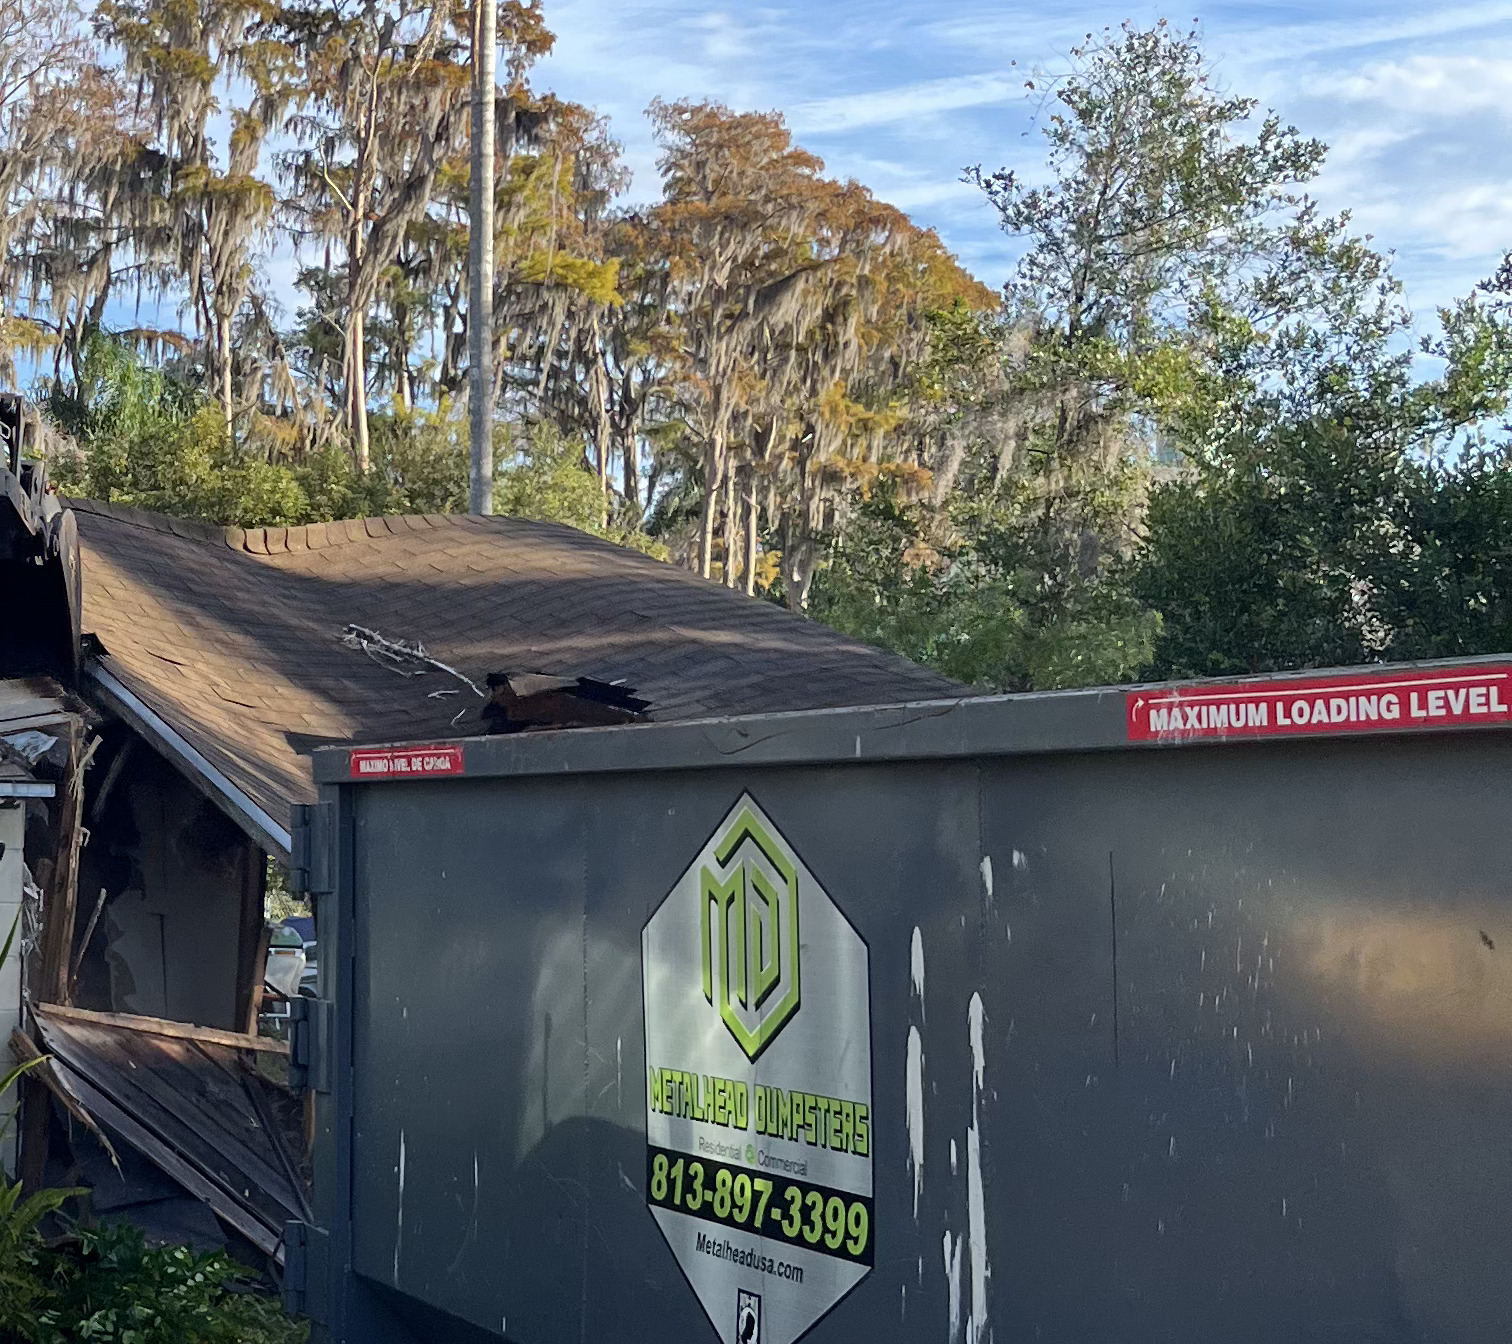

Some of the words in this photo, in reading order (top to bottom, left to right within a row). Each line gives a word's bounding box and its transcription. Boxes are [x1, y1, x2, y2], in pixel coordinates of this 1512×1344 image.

[1149, 701, 1269, 732] MAXIMUM
[1276, 694, 1400, 725] LOADING
[1410, 685, 1508, 718] LEVEL
[411, 757, 422, 771] DE
[649, 1066, 748, 1131] METALHEAD
[754, 1084, 870, 1157] DUMPSTERS
[698, 1136, 742, 1161] Residential
[758, 1150, 808, 1176] Commercial
[651, 1153, 869, 1256] 813-897-3399
[695, 1231, 804, 1284] Metalheadusa.com
